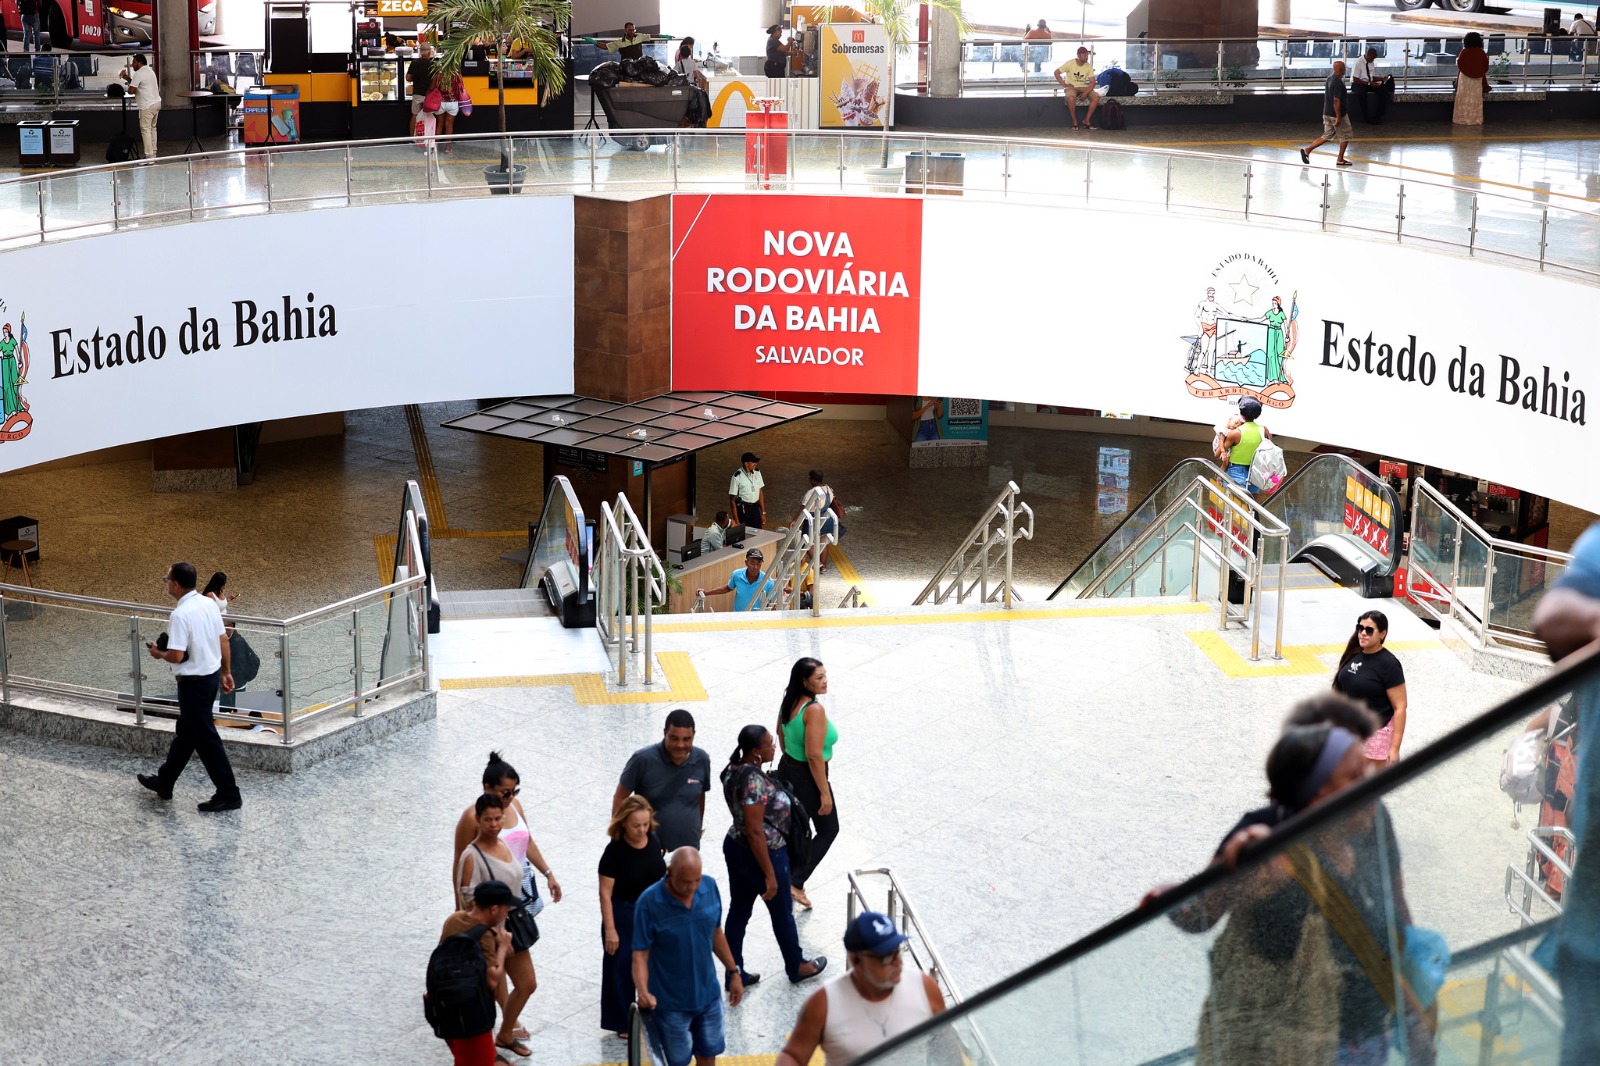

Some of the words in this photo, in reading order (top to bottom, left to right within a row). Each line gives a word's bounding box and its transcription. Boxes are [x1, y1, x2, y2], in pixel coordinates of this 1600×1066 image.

[380, 0, 424, 12] ZECA
[81, 24, 102, 37] 10020
[832, 43, 884, 54] Sobremesas
[764, 231, 854, 257] NOVA
[708, 262, 909, 297] RODOVIÁRIA
[1211, 252, 1242, 277] ESTADO
[1257, 258, 1279, 285] BAHIA
[735, 305, 777, 329] DA
[787, 306, 880, 333] BAHIA
[50, 315, 166, 379] Estado
[179, 307, 221, 355] da
[232, 292, 338, 347] Bahia
[756, 346, 863, 365] SALVADOR
[1320, 320, 1436, 386] Estado
[1448, 345, 1485, 398] da
[1496, 355, 1585, 426] Bahia
[1195, 389, 1214, 397] PER
[1219, 387, 1250, 396] ARDUA
[0, 431, 23, 440] URGO
